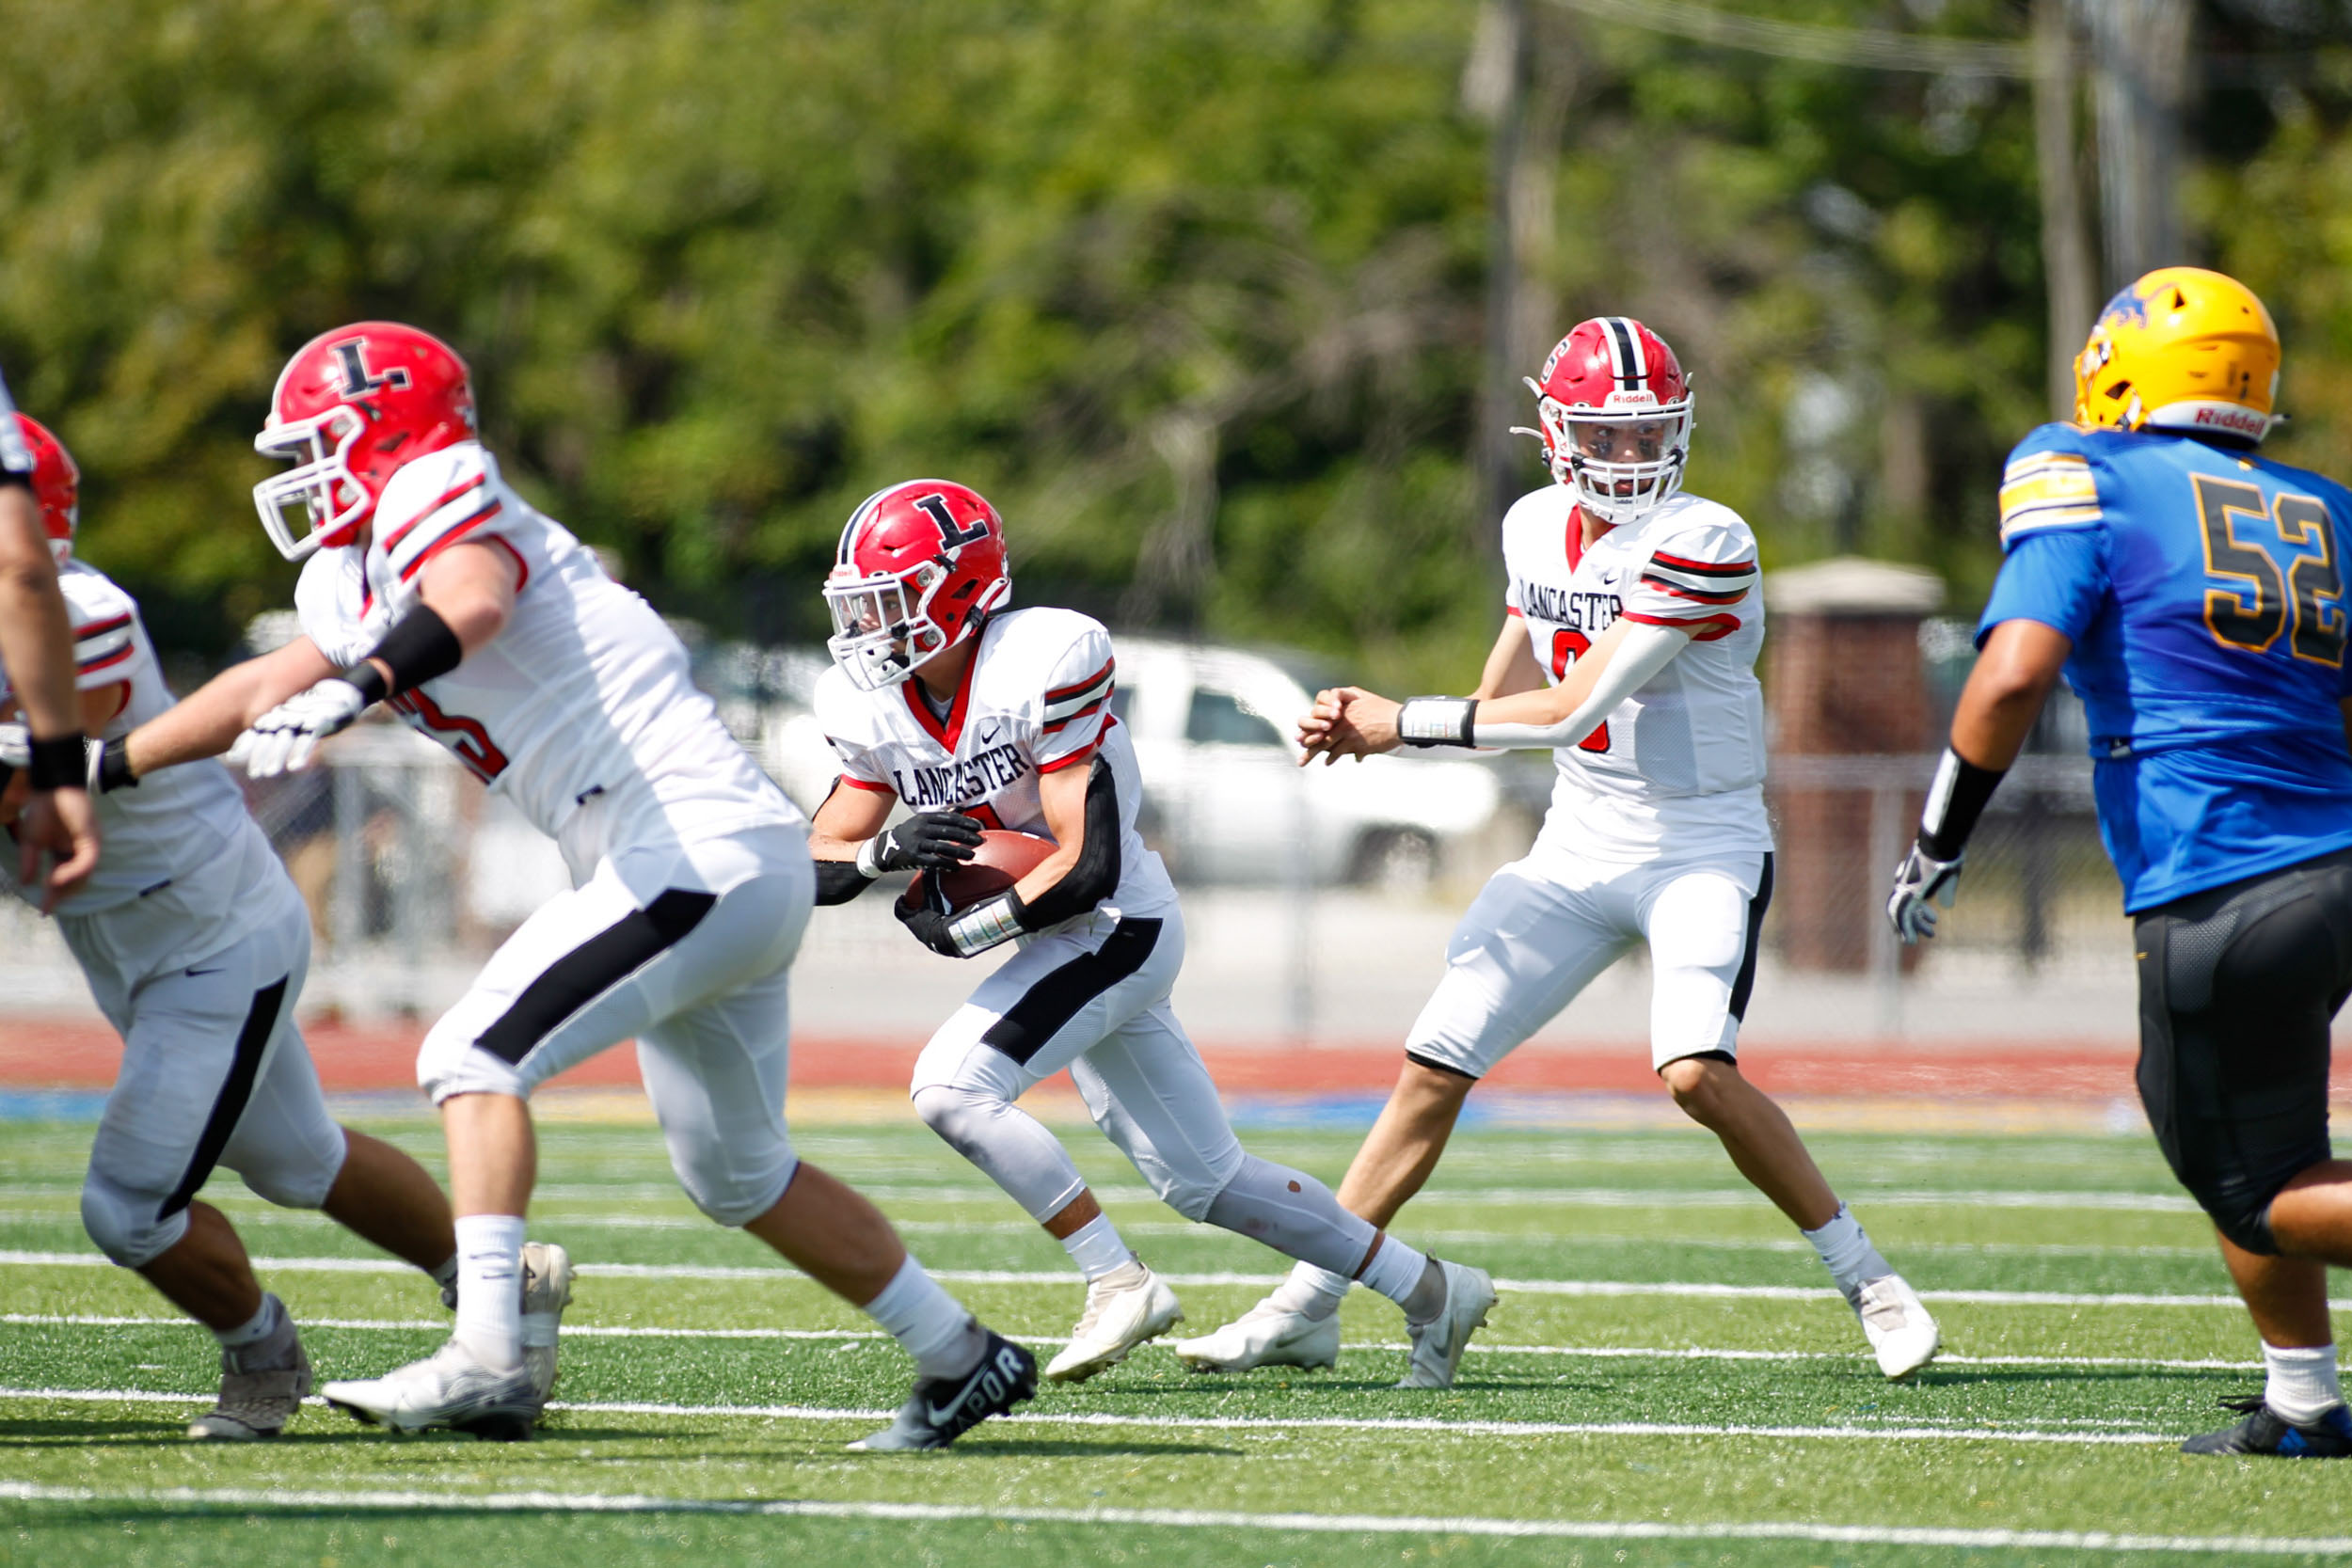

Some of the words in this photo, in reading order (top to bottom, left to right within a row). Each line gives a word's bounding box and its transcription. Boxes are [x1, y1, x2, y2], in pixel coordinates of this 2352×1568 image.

[326, 336, 413, 403] L
[1613, 393, 1653, 404] Riddell
[2194, 407, 2265, 436] Riddell
[913, 493, 990, 553] L
[2188, 471, 2348, 670] 52
[893, 742, 1030, 806] LANCASTER
